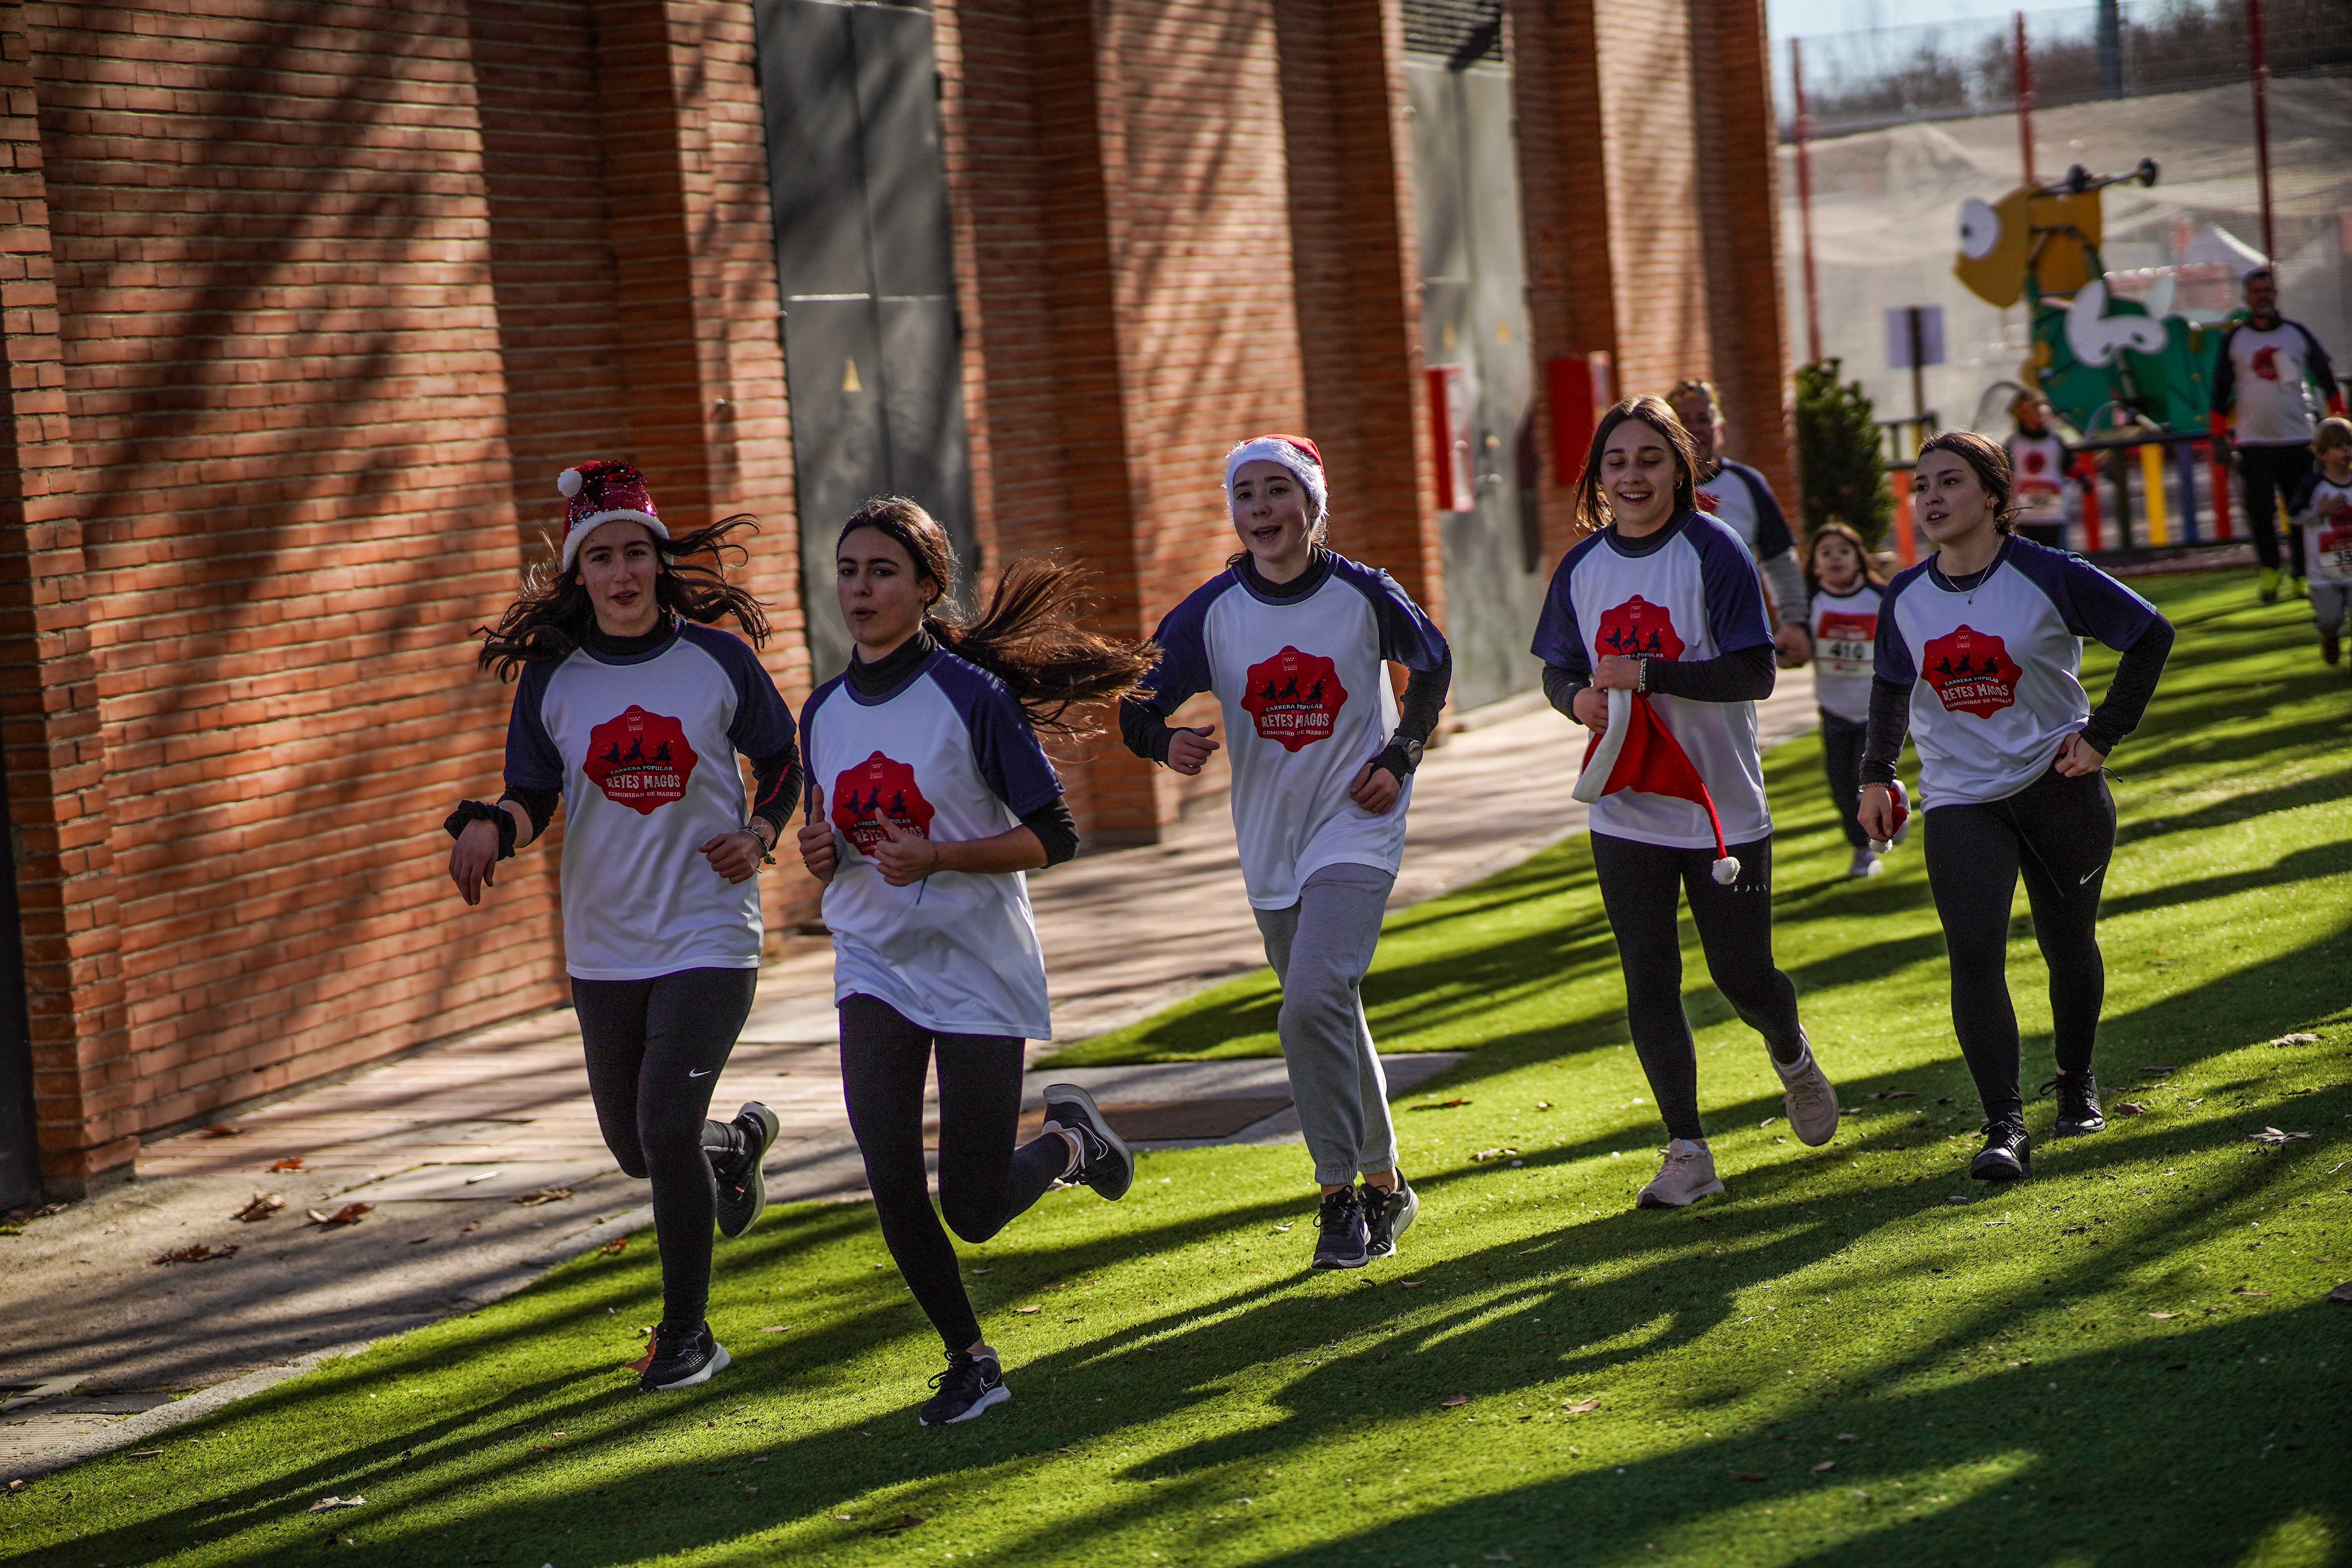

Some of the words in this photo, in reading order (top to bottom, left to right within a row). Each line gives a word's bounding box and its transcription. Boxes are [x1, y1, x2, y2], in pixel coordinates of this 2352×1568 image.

[1945, 677, 1973, 686] CARRERA
[1941, 686, 1975, 701] REYES
[1976, 684, 2009, 697] MAGOS
[1946, 699, 1981, 708] COMUNIDAD
[1261, 714, 1293, 727] REYES
[1295, 713, 1329, 728] MAGOS
[611, 766, 641, 775] CARRERA
[606, 775, 639, 789] REYES
[644, 775, 681, 789] MAGOS
[853, 829, 887, 842] REYES
